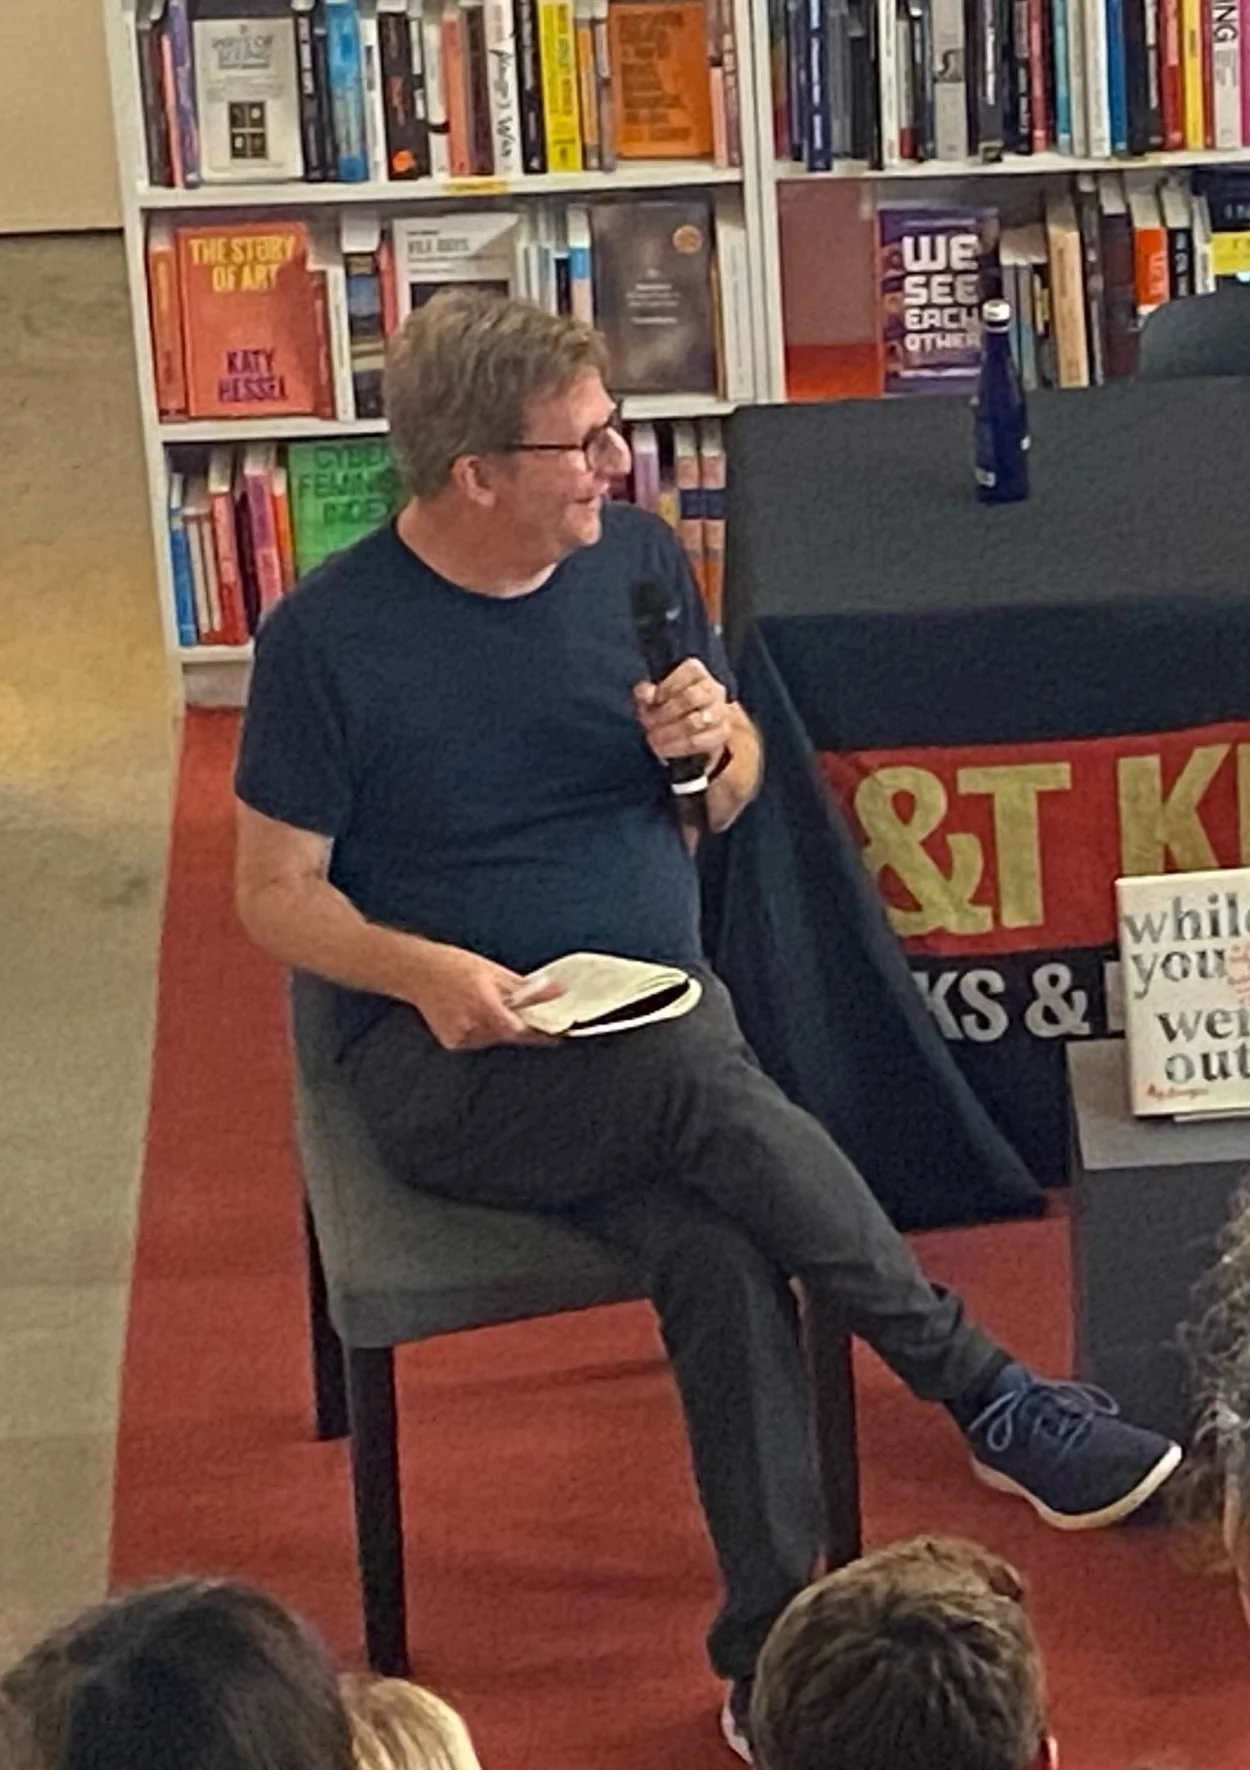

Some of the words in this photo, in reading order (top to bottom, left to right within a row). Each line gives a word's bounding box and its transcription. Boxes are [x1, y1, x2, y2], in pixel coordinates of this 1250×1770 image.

[188, 238, 230, 265] THE
[232, 235, 298, 264] STORY
[901, 235, 979, 272] WE
[212, 264, 237, 293] OF
[240, 261, 279, 291] ART
[903, 273, 980, 306] SEE
[904, 306, 979, 331] EACH
[903, 331, 982, 353] OTHER
[226, 347, 275, 374] KATY
[217, 375, 287, 403] HESSEL
[854, 762, 1072, 938] &T
[1131, 948, 1228, 1000] you
[1024, 962, 1092, 1038] &
